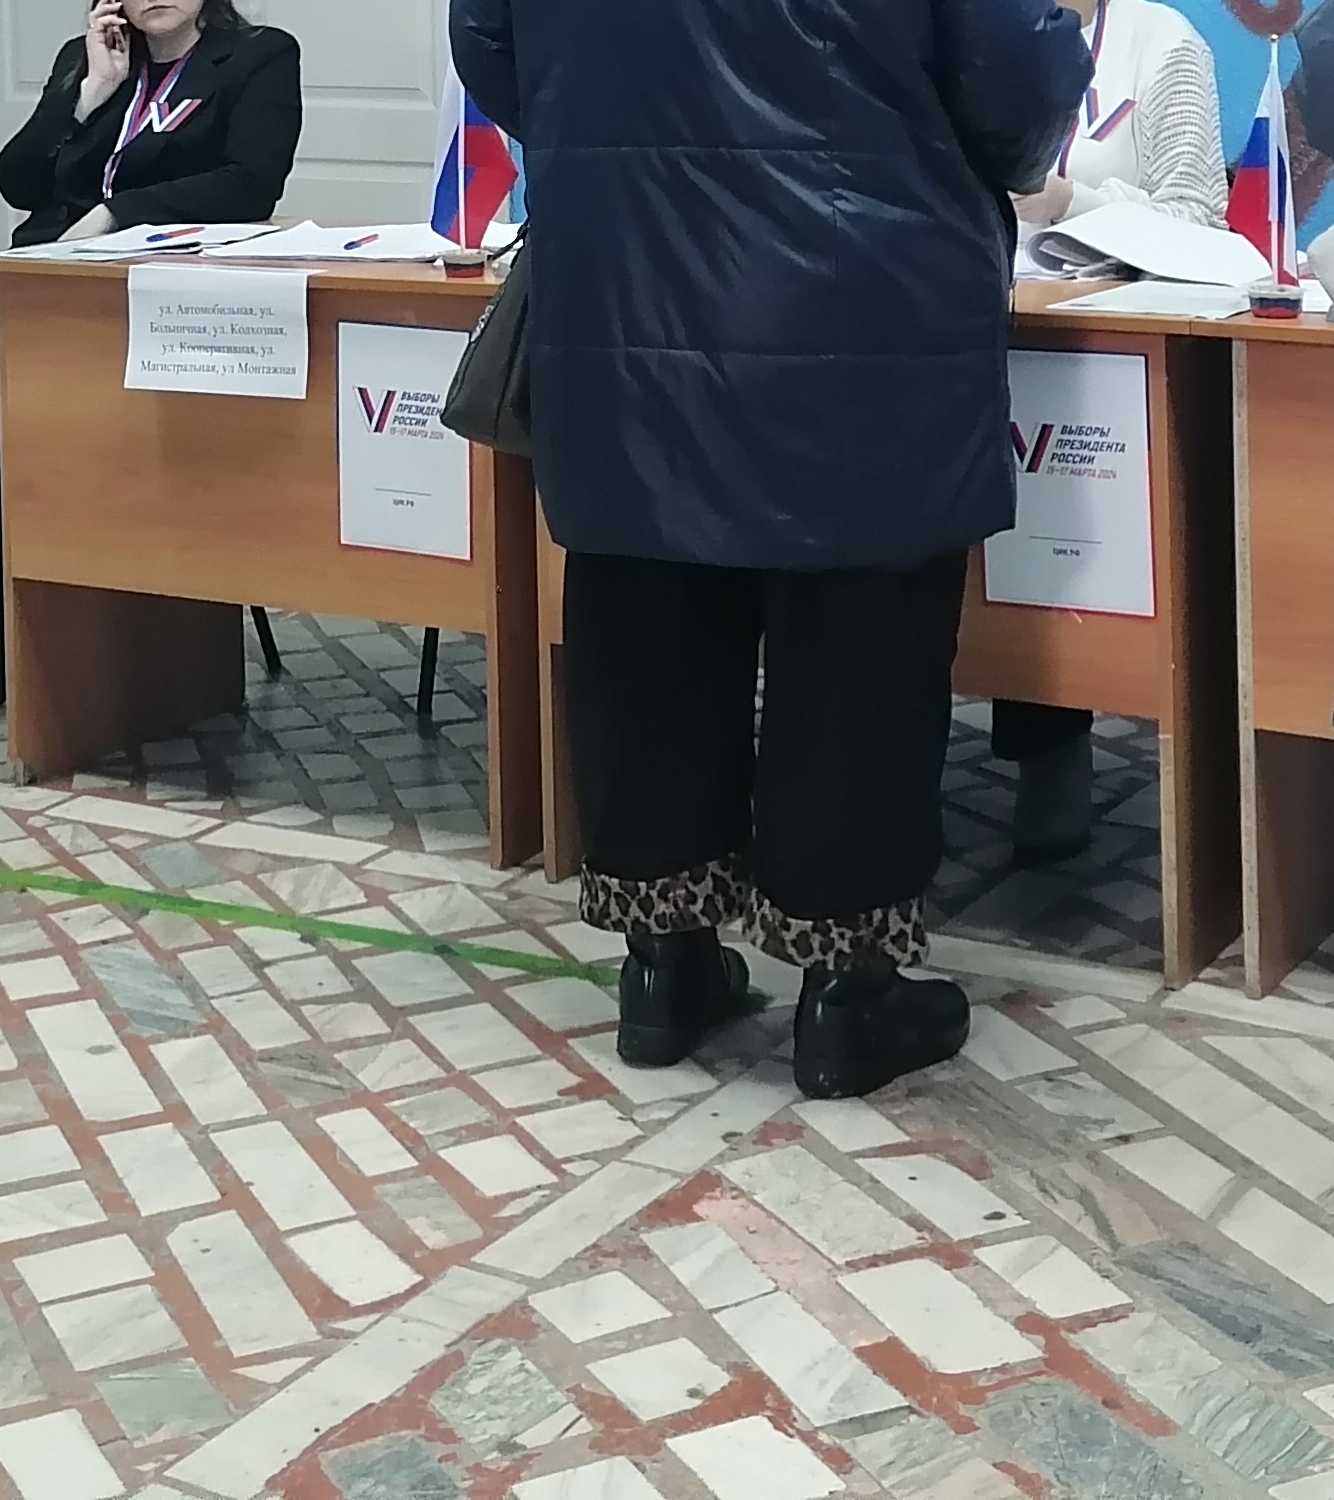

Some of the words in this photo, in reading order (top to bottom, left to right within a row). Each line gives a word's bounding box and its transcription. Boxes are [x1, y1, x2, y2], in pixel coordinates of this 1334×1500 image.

[158, 305, 173, 317] ул.
[176, 303, 257, 317] Автомобильная,
[259, 306, 275, 319] ул.
[149, 321, 211, 336] Больничная,
[212, 325, 228, 338] ул.
[230, 323, 288, 338] Колхозная,
[179, 341, 259, 357] Кооперативная,
[260, 346, 276, 358] ул.
[140, 360, 219, 375] Магистральная,
[237, 362, 297, 376] Монтажная
[400, 390, 441, 404] ВЫБОРЫ
[396, 403, 442, 417] ПРЕЗИДЕН
[392, 415, 429, 428] РОССИИ
[407, 429, 428, 439] МАРТА
[1060, 424, 1111, 438] ВЫБОРЫ
[1055, 438, 1126, 453] ПРЕЗИДЕНТА
[1049, 452, 1096, 466] РОССИИ
[1069, 467, 1097, 478] МАРТА
